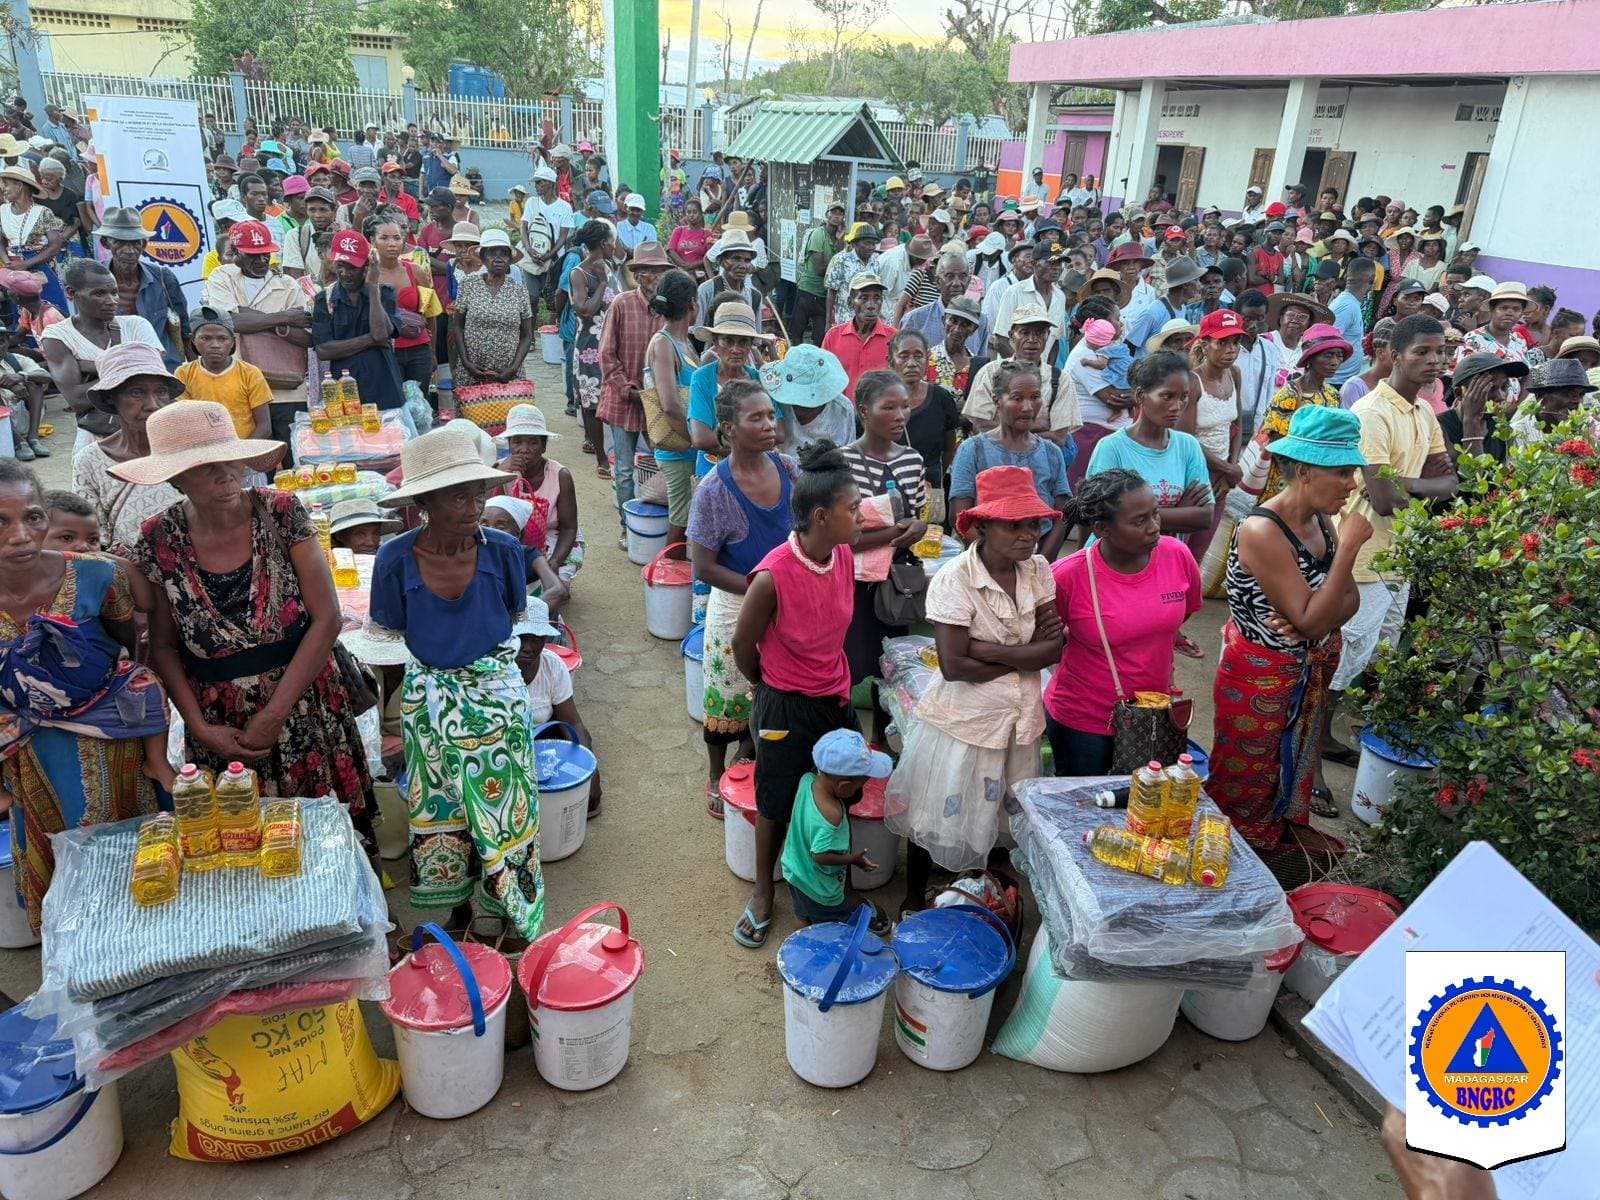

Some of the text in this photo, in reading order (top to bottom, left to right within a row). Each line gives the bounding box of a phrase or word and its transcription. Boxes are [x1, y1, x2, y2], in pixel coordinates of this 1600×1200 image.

[250, 229, 265, 245] LA
[155, 248, 185, 260] BNGRC
[251, 1007, 326, 1049] 50 KG
[267, 1024, 325, 1058] Poids Net
[223, 1112, 298, 1125] 25% brisures
[313, 1108, 330, 1121] Riz
[200, 1117, 226, 1134] longs
[229, 1127, 264, 1137] grains
[279, 1119, 311, 1134] blanc
